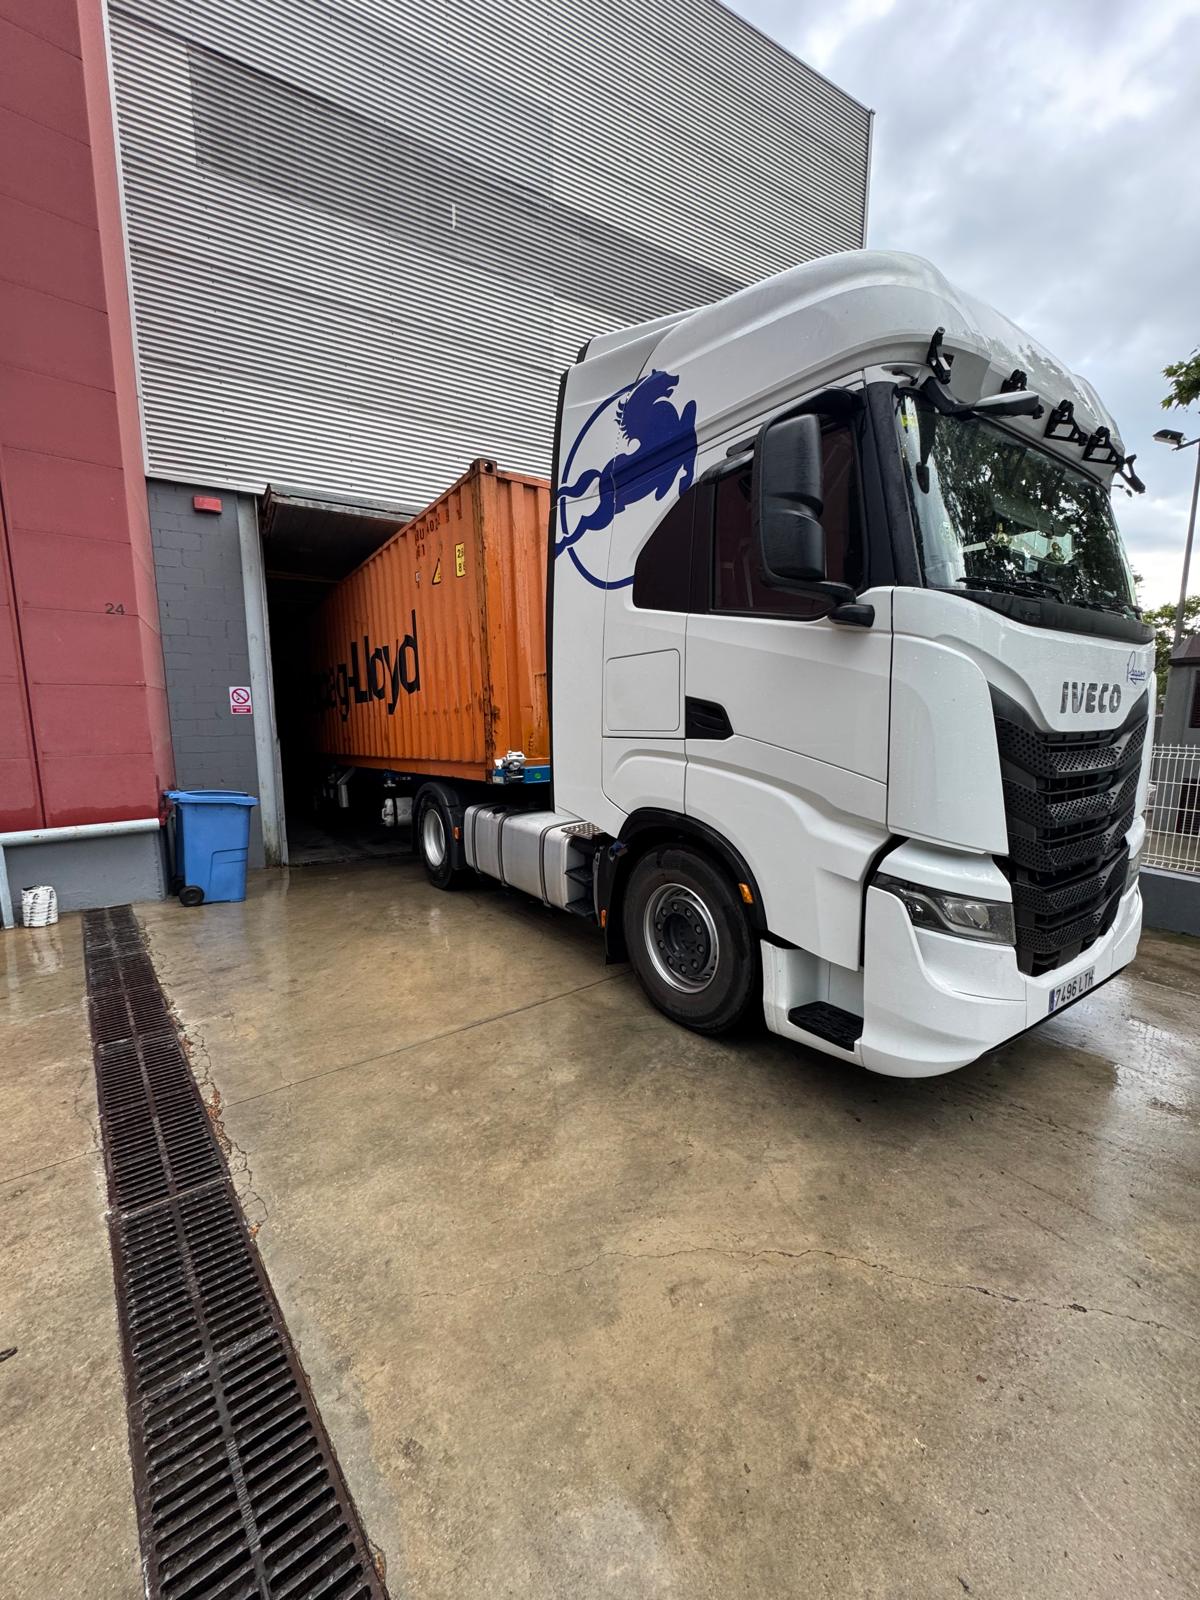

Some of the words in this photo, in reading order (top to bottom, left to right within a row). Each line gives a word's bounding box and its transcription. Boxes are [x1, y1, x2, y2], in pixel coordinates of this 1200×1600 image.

[104, 602, 125, 616] 24
[1060, 681, 1122, 714] IVECO
[1055, 980, 1077, 1008] 7496
[1079, 969, 1094, 992] LTH
